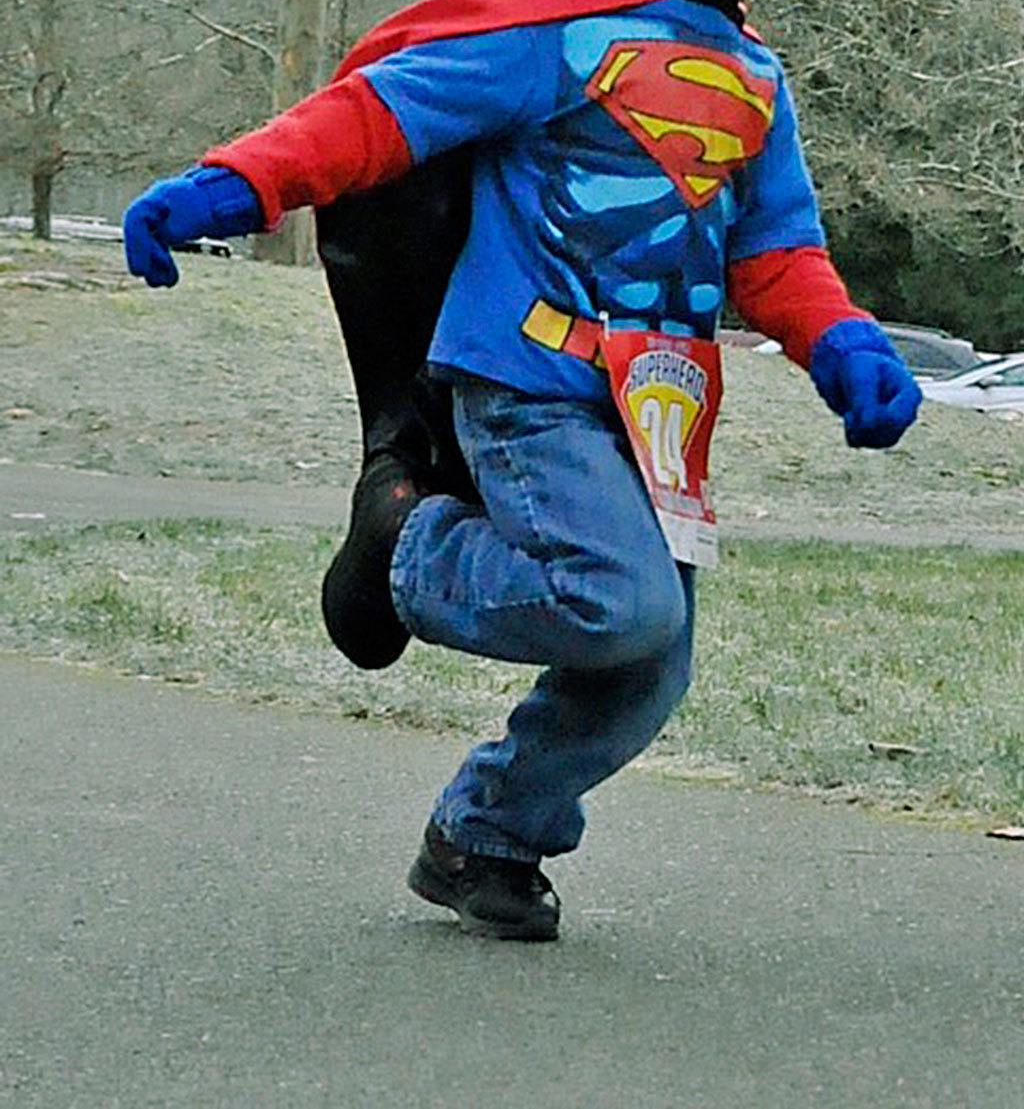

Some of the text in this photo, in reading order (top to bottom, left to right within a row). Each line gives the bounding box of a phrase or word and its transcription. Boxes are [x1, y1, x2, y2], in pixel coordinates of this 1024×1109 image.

[587, 41, 776, 206] S
[628, 352, 705, 403] SUPERHERO
[639, 397, 688, 491] 24
